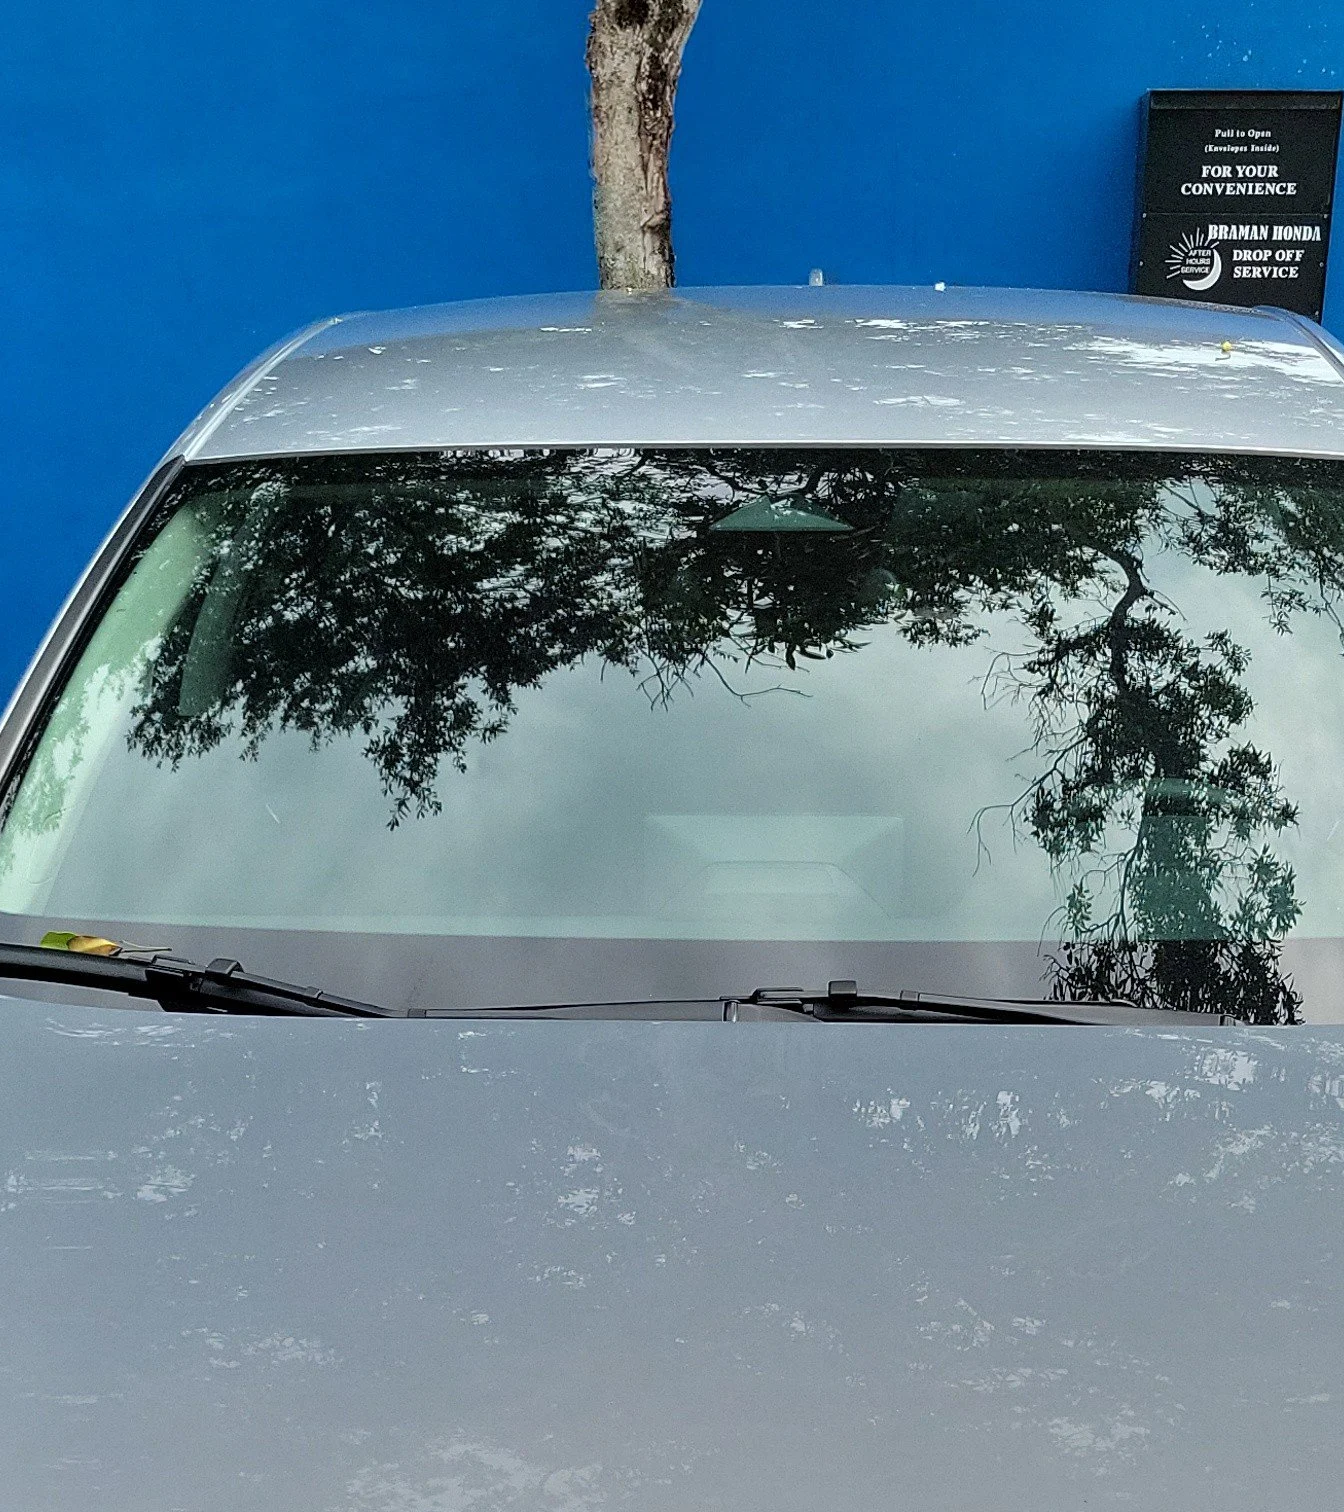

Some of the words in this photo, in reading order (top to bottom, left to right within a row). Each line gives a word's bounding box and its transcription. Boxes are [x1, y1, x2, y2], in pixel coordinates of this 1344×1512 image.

[1201, 165, 1233, 178] FOR
[1235, 165, 1279, 178] YOUR
[1181, 182, 1297, 196] CONVENIENCE
[1208, 224, 1269, 241] BRAMAN
[1272, 226, 1321, 241] HONDA
[1232, 249, 1273, 262] DROP
[1274, 249, 1305, 262] OFF
[1233, 266, 1299, 278] SERVICE
